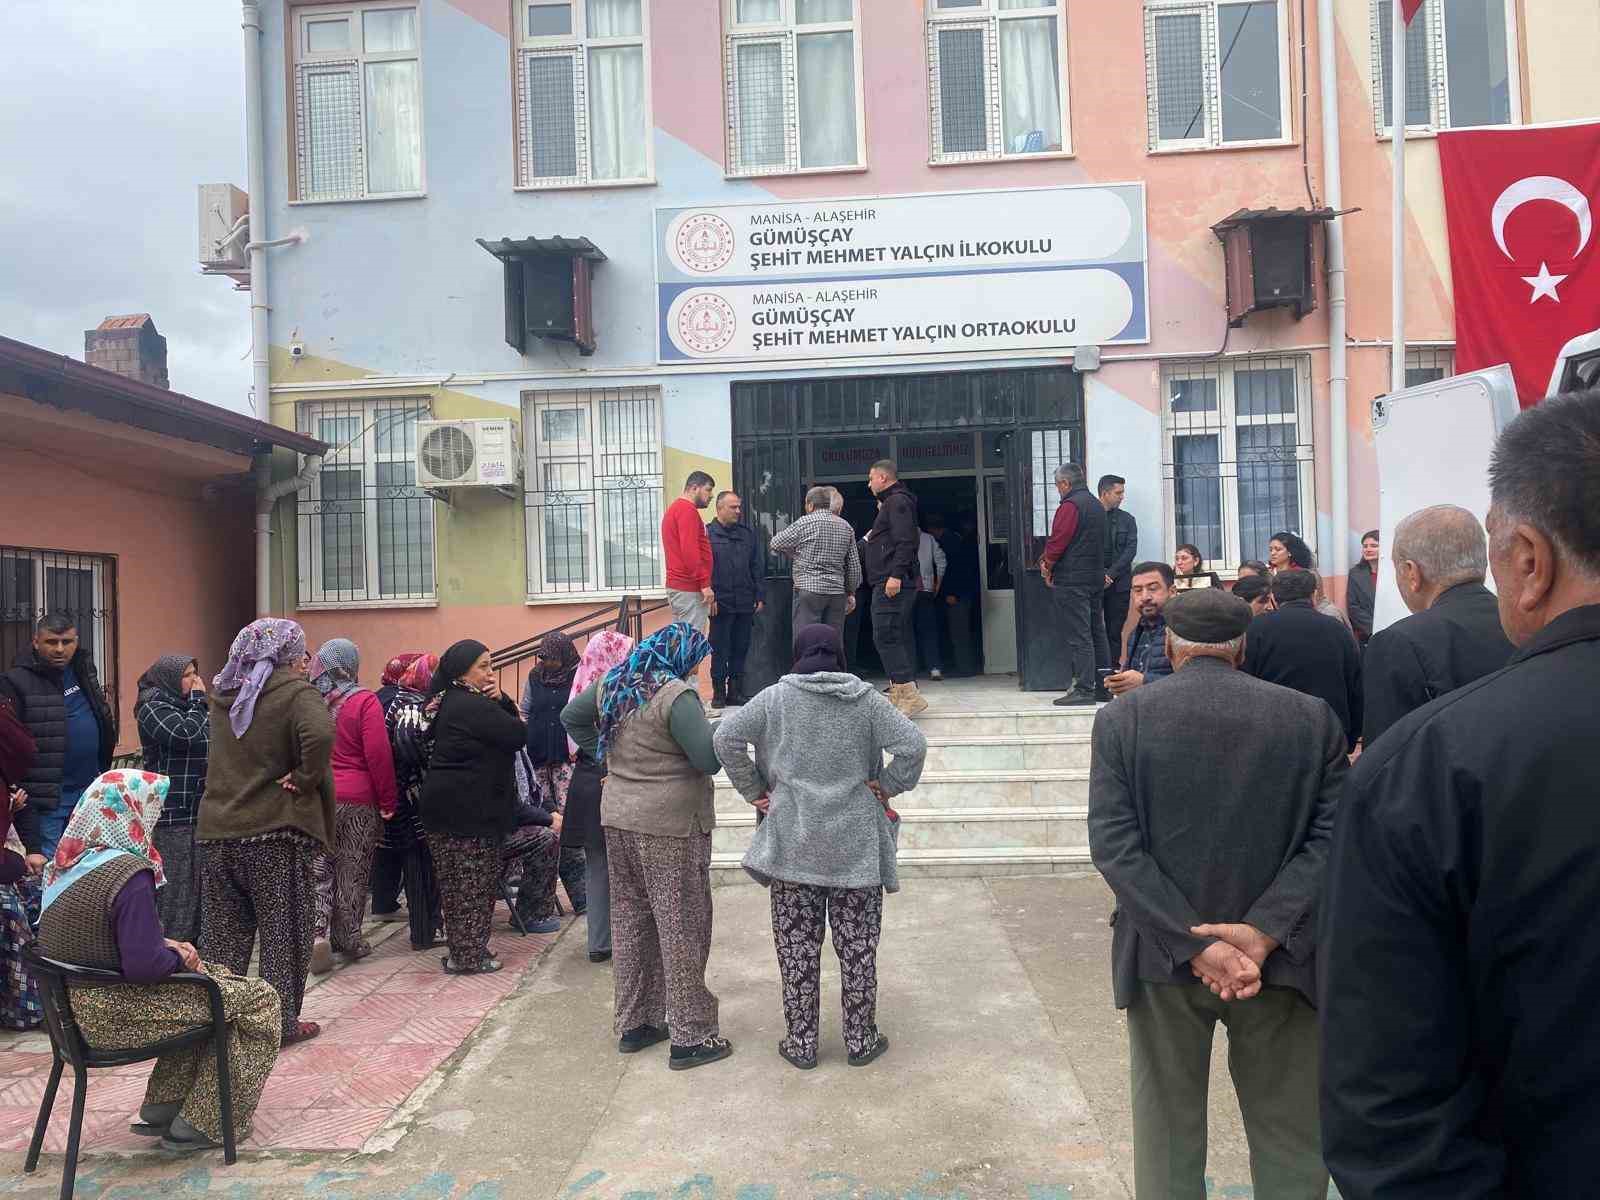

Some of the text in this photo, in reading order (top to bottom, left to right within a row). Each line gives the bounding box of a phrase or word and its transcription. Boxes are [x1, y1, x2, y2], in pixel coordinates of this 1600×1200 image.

[750, 212, 802, 225] MANİSA
[813, 208, 876, 224] ALAŞEHİR
[750, 227, 853, 247] GÜMÜŞÇAY
[750, 238, 1052, 271] ŞEHİT MEHMET YALÇIN İLKOKULU
[752, 291, 804, 305] MANİSA
[815, 287, 878, 304] ALAŞEHİR
[752, 307, 855, 327] GÜMÜŞÇAY
[752, 318, 1076, 351] ŞEHİT MEHMET YALÇIN ORTAOKULU
